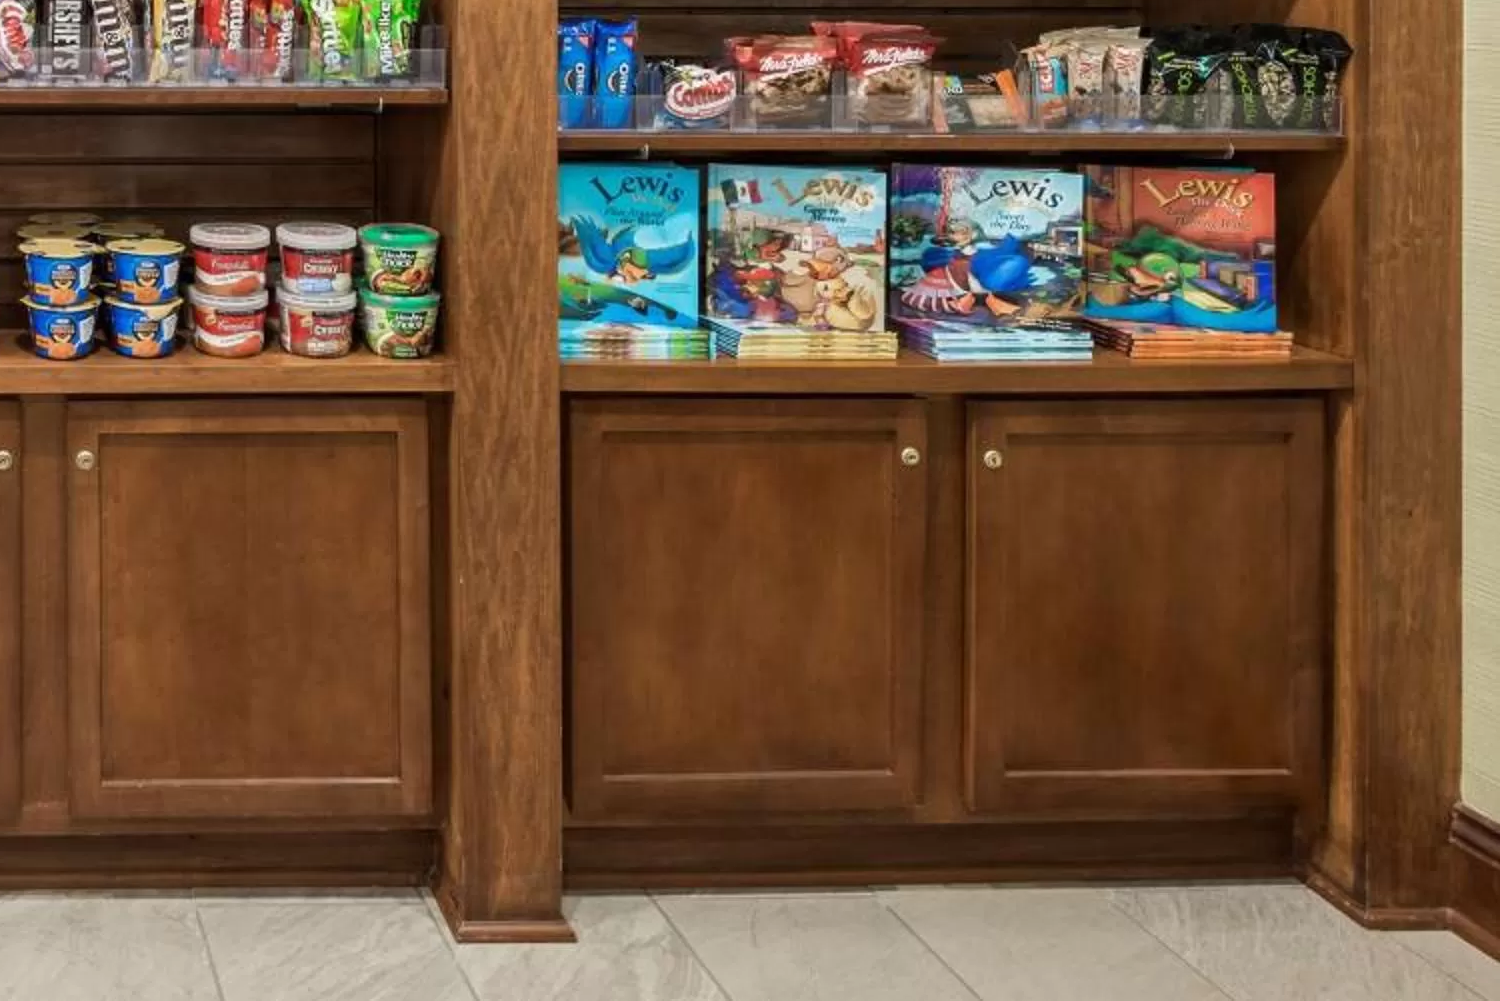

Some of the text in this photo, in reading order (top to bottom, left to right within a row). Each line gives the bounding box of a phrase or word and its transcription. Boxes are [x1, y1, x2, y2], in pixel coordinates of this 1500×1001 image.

[588, 170, 685, 205] Lewis
[771, 175, 875, 207] Lewis
[960, 177, 1064, 208] Lewis
[1139, 178, 1254, 209] Lewis
